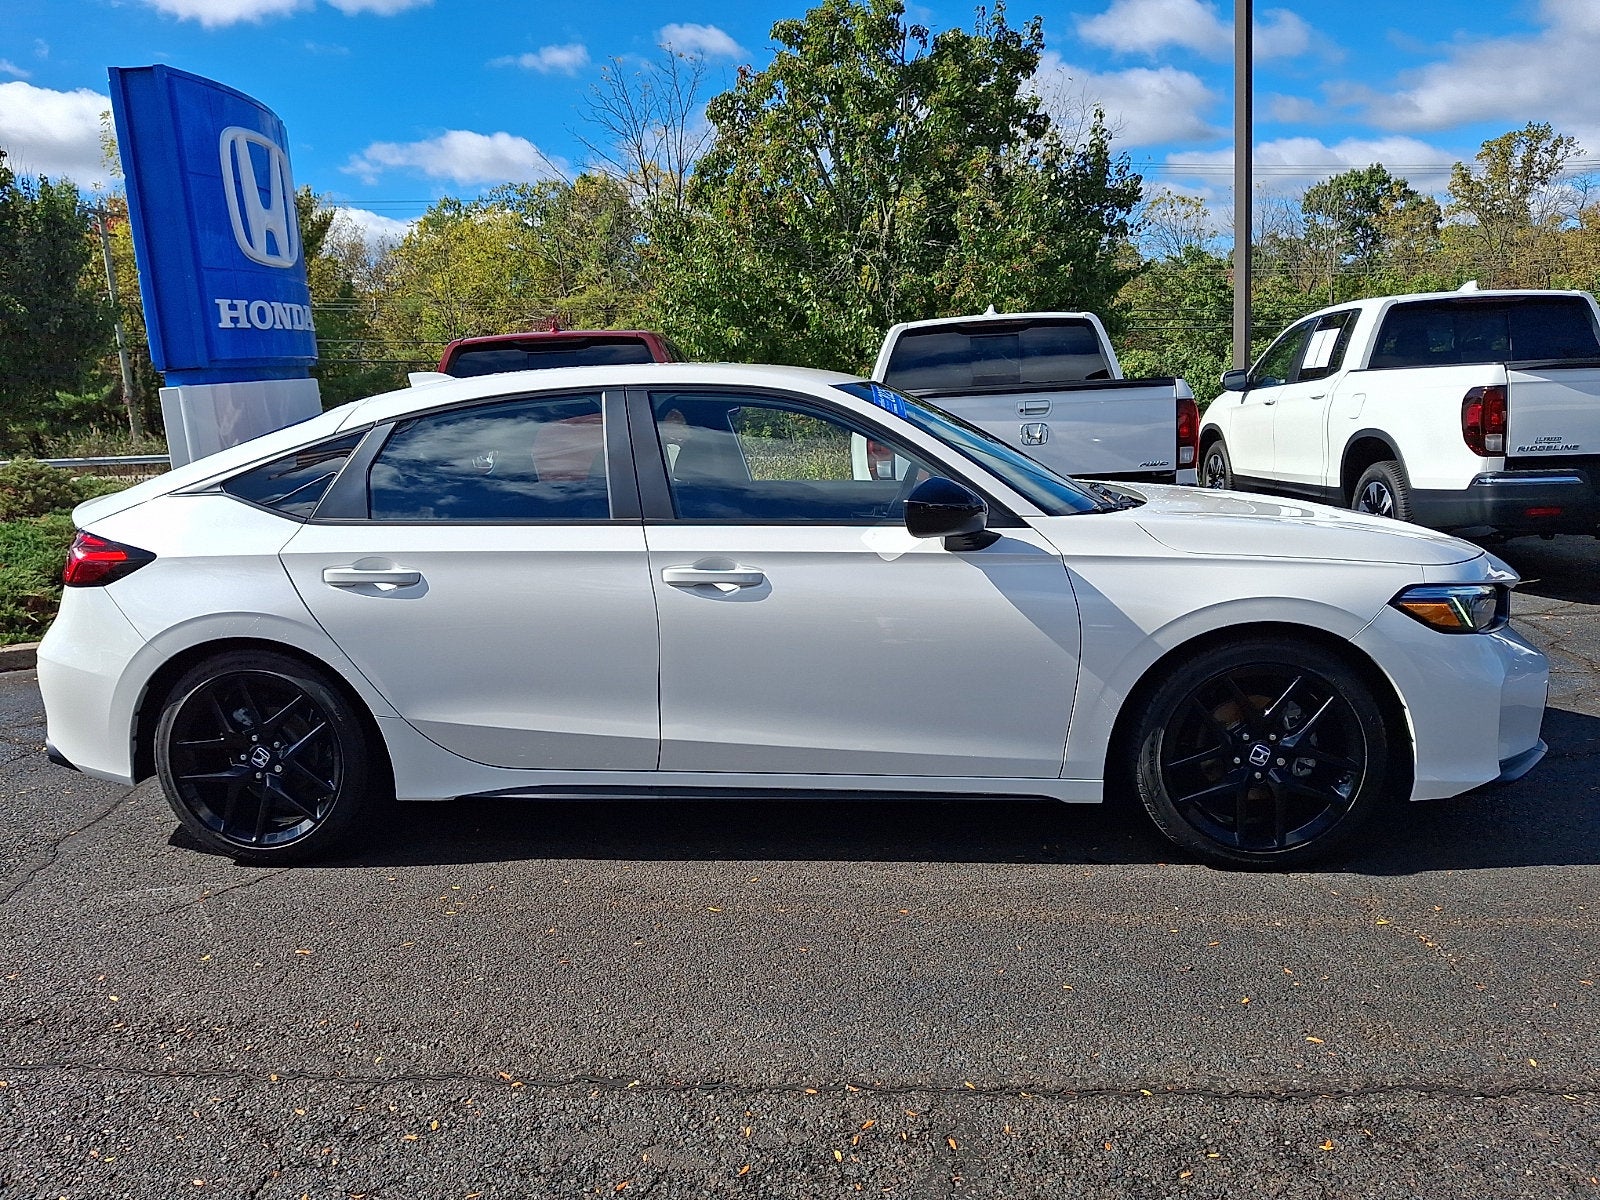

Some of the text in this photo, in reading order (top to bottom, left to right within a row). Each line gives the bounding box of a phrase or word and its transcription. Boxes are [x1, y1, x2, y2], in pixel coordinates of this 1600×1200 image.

[215, 299, 316, 331] HONDA
[1517, 444, 1580, 453] RIDGELINE
[1139, 460, 1169, 468] AWD
